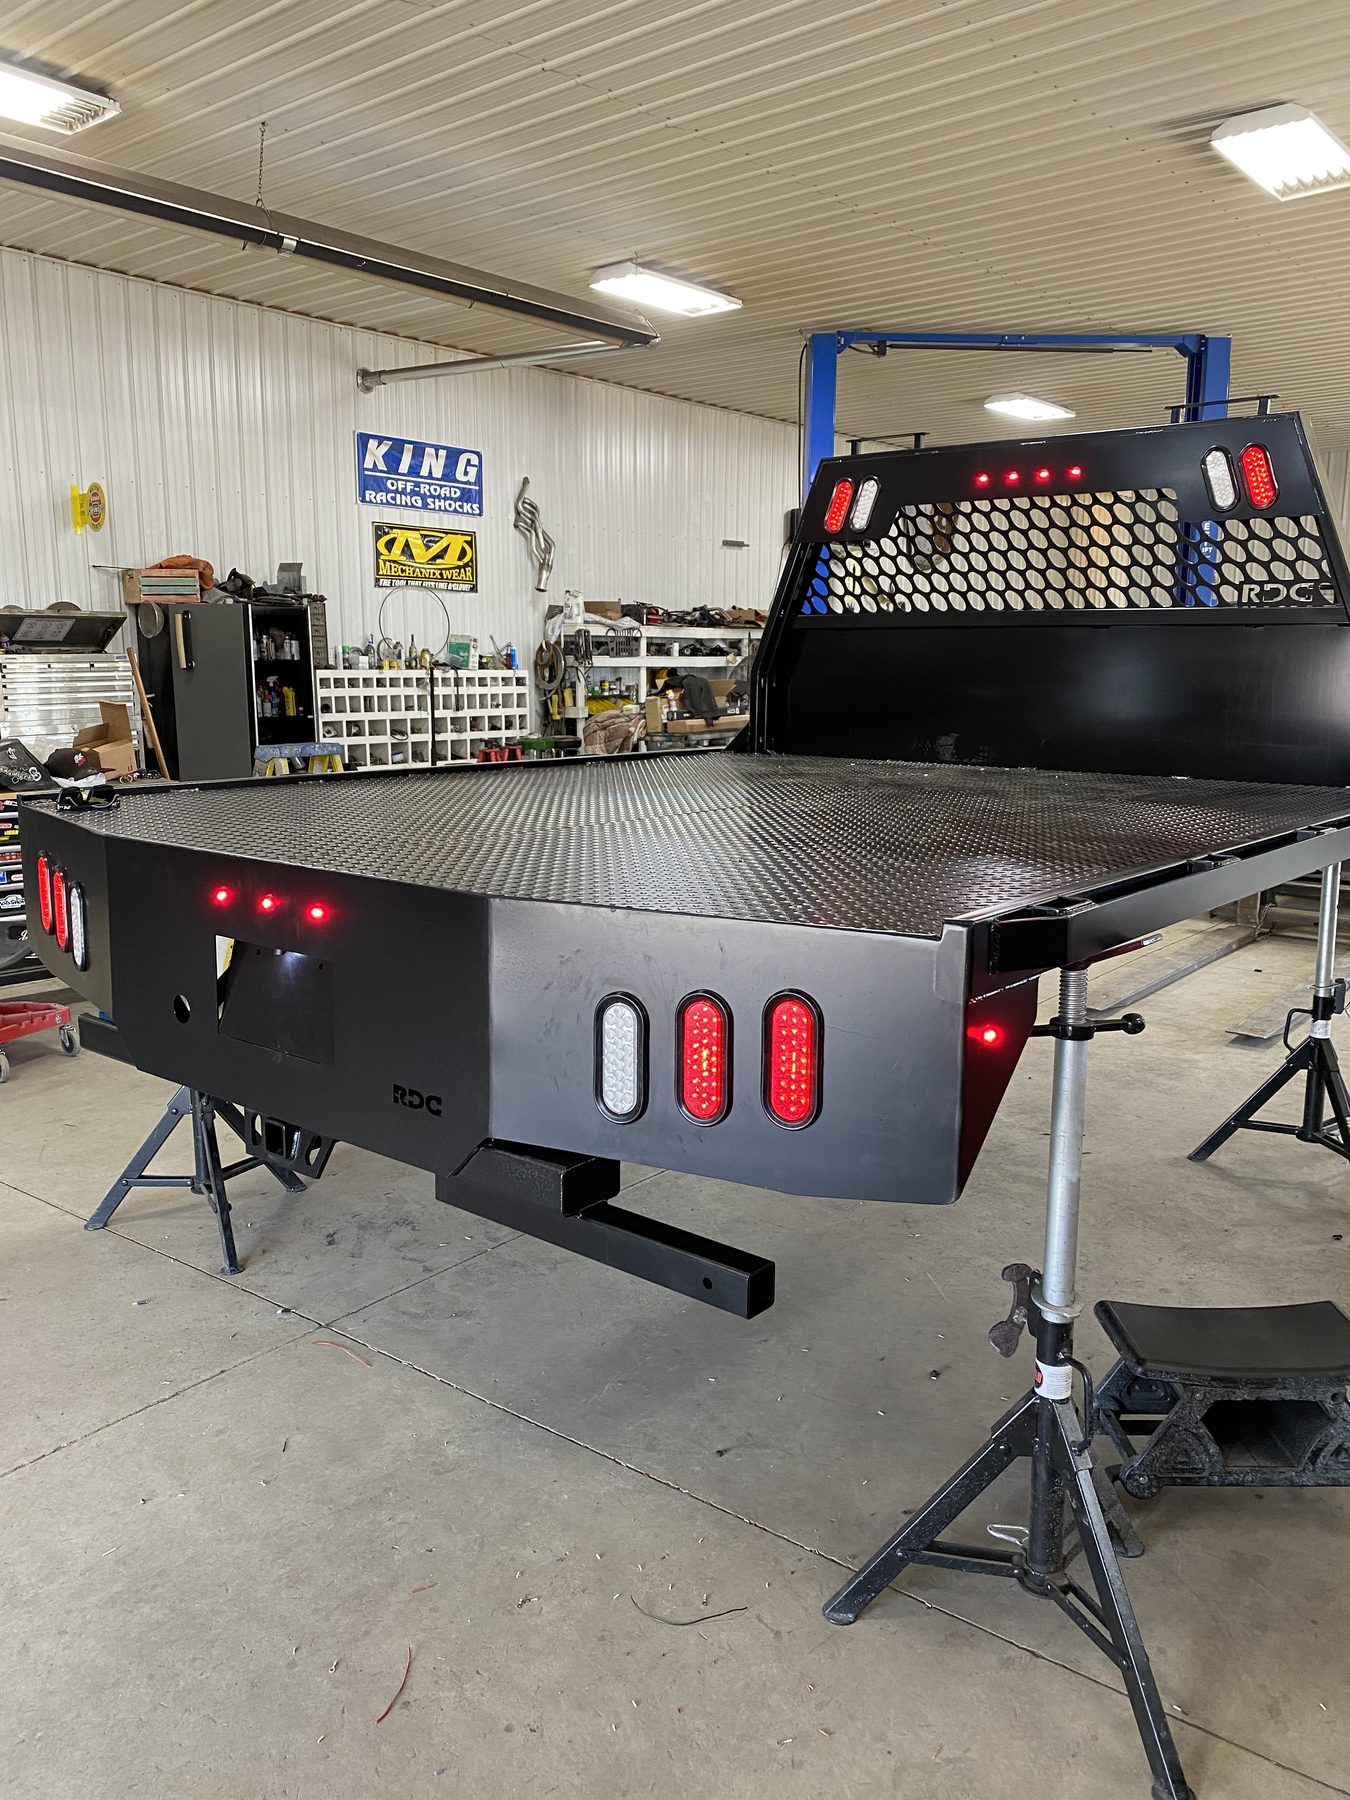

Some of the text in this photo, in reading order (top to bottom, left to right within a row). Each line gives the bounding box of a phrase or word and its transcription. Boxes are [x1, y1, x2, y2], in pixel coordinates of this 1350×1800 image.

[363, 438, 479, 483] KING
[386, 479, 461, 498] OFF-ROAD
[365, 490, 480, 514] RACING SHOCKS
[378, 559, 473, 581] MECHANIX WEAR
[379, 579, 392, 587] THE
[392, 1083, 442, 1118] RDC
